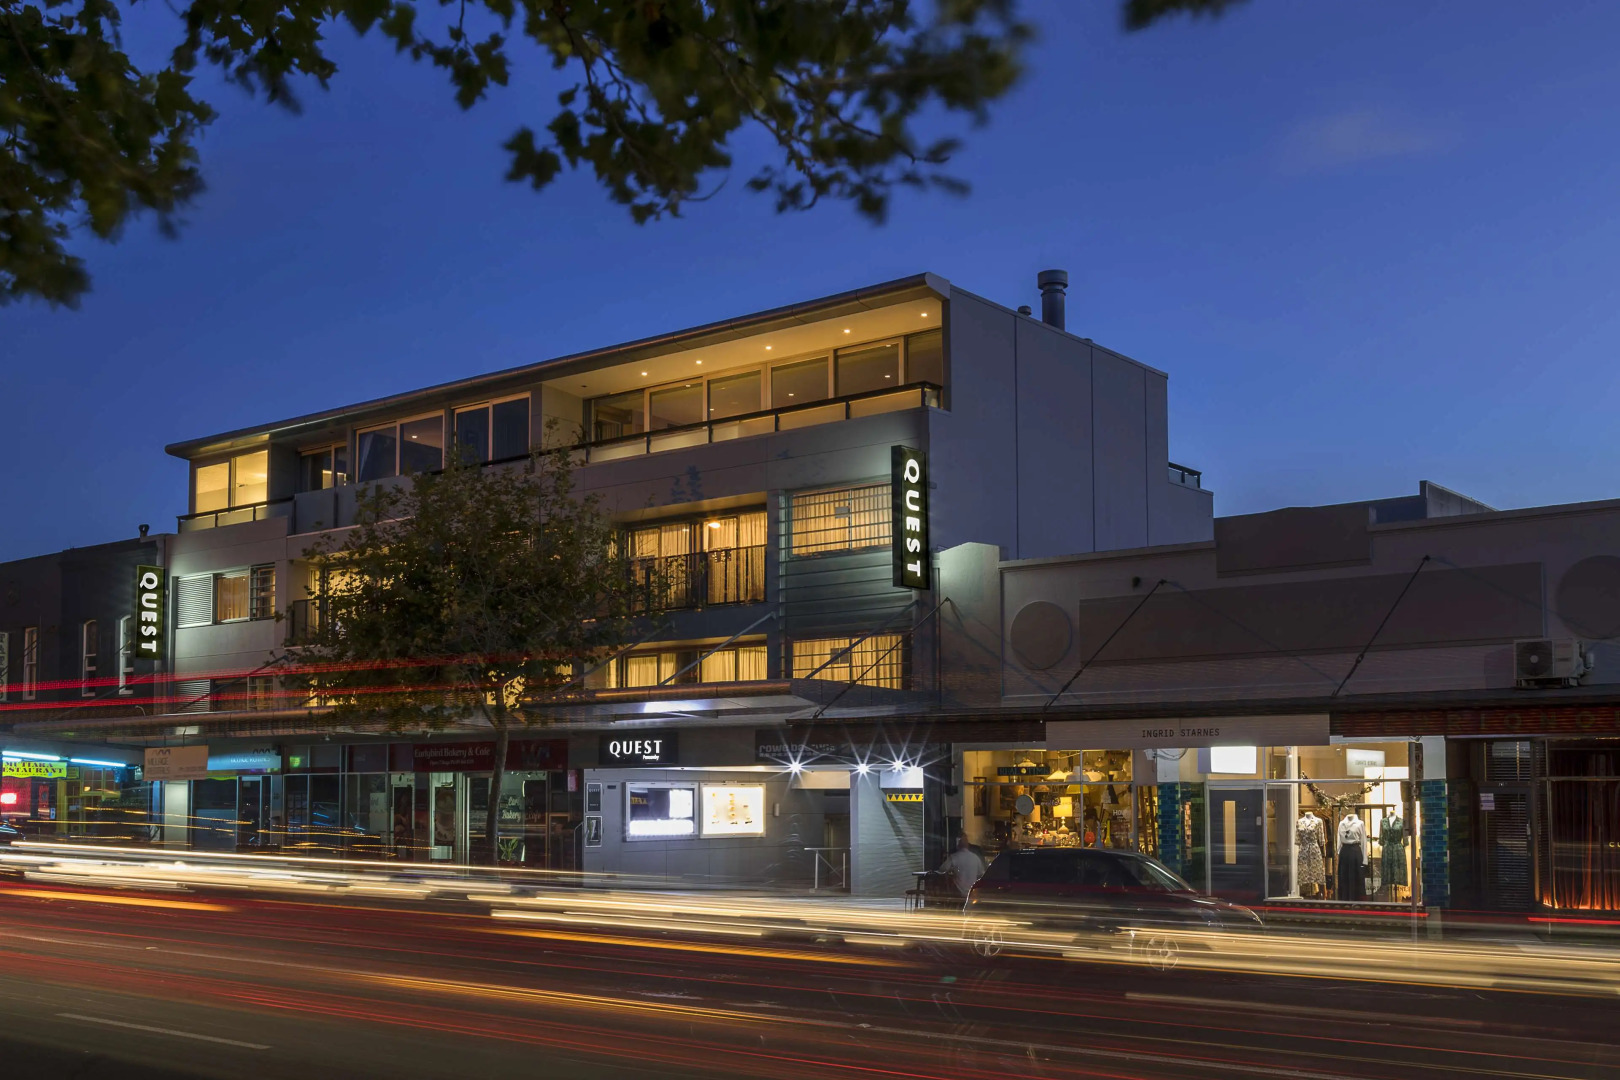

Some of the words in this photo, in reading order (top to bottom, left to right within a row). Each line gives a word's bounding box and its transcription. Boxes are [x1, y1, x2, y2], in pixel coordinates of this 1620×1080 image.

[903, 458, 921, 577] QUEST
[139, 572, 158, 653] QUEST
[1142, 729, 1175, 738] INGRID
[1180, 728, 1220, 737] STARNES
[444, 747, 467, 758] Bakery
[468, 747, 474, 756] &
[475, 746, 490, 756] Cafe
[609, 740, 663, 758] QUEST
[2, 766, 64, 774] ESTAURANT
